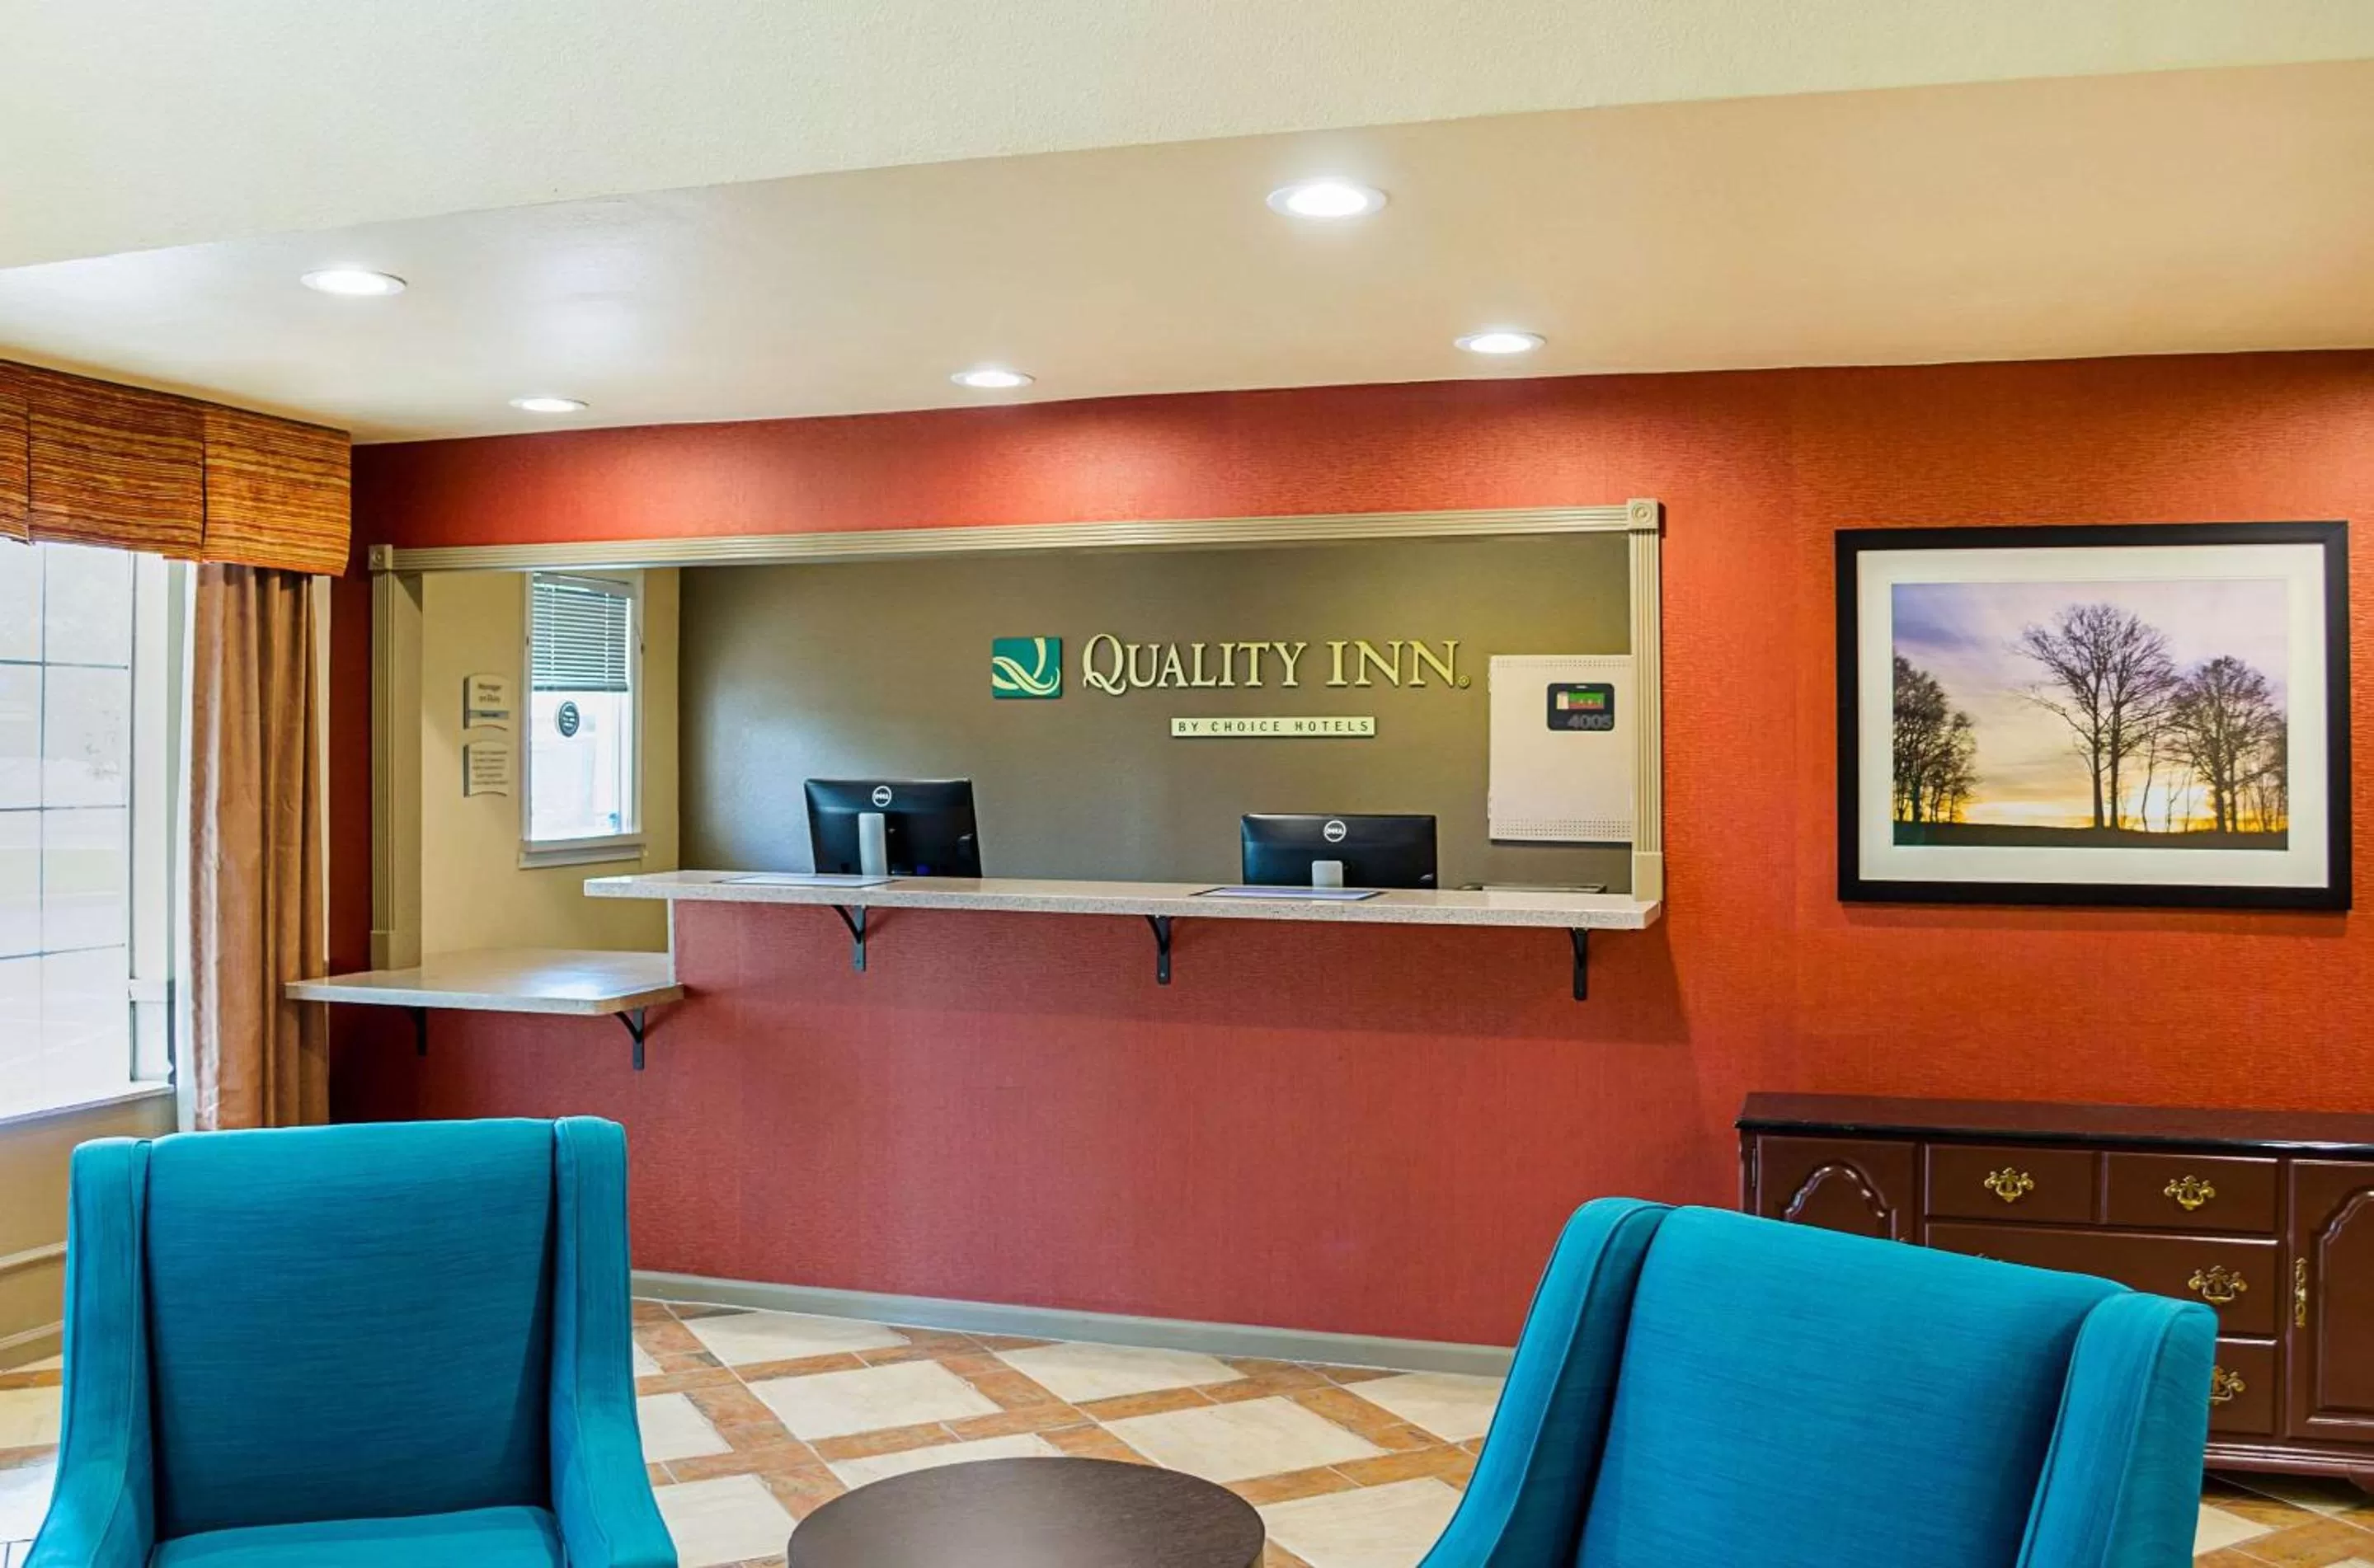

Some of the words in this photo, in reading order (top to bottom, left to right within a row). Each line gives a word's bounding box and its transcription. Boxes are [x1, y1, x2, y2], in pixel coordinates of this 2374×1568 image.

[1083, 633, 1307, 696] QUALITY
[1178, 721, 1199, 732] BY
[1211, 721, 1281, 732] CHOICE
[1295, 721, 1369, 732] HOTELS
